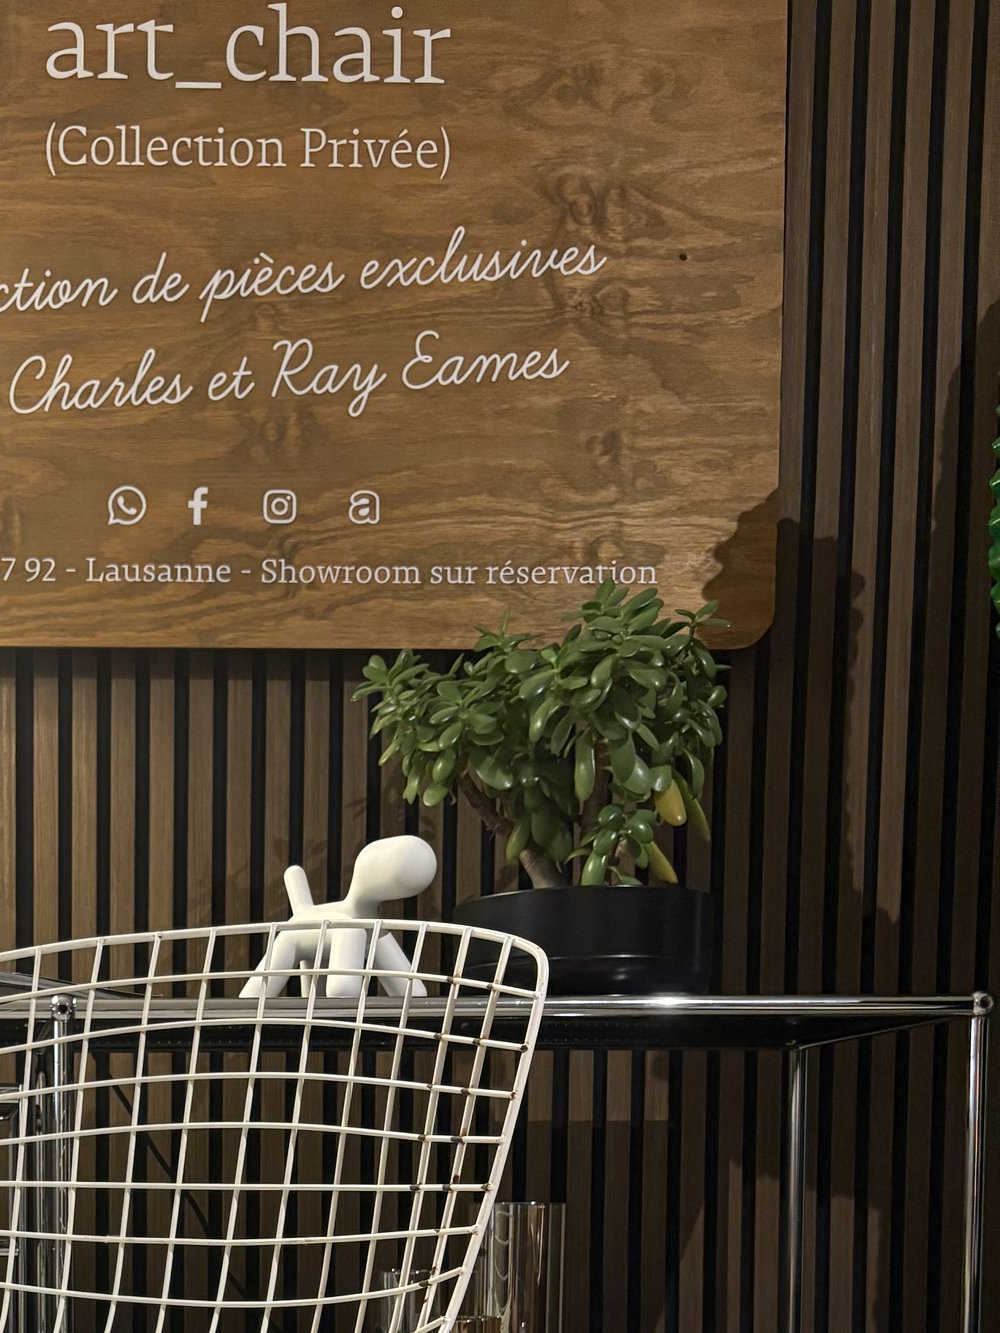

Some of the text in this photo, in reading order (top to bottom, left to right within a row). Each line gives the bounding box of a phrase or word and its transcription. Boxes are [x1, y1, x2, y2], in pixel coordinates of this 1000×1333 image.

[45, 2, 451, 89] art_chair
[45, 121, 451, 180] (Collection Privée)
[131, 251, 190, 304] de
[198, 251, 346, 323] pièces
[359, 225, 608, 290] exclusives
[9, 347, 194, 415] Charles
[207, 356, 256, 401] et
[271, 338, 388, 418] Ray
[401, 329, 570, 390] Eames
[24, 557, 56, 582] 92
[85, 557, 231, 583] Lausanne
[261, 558, 422, 584] Showroom
[429, 565, 479, 585] sur
[485, 559, 658, 585] réservation
